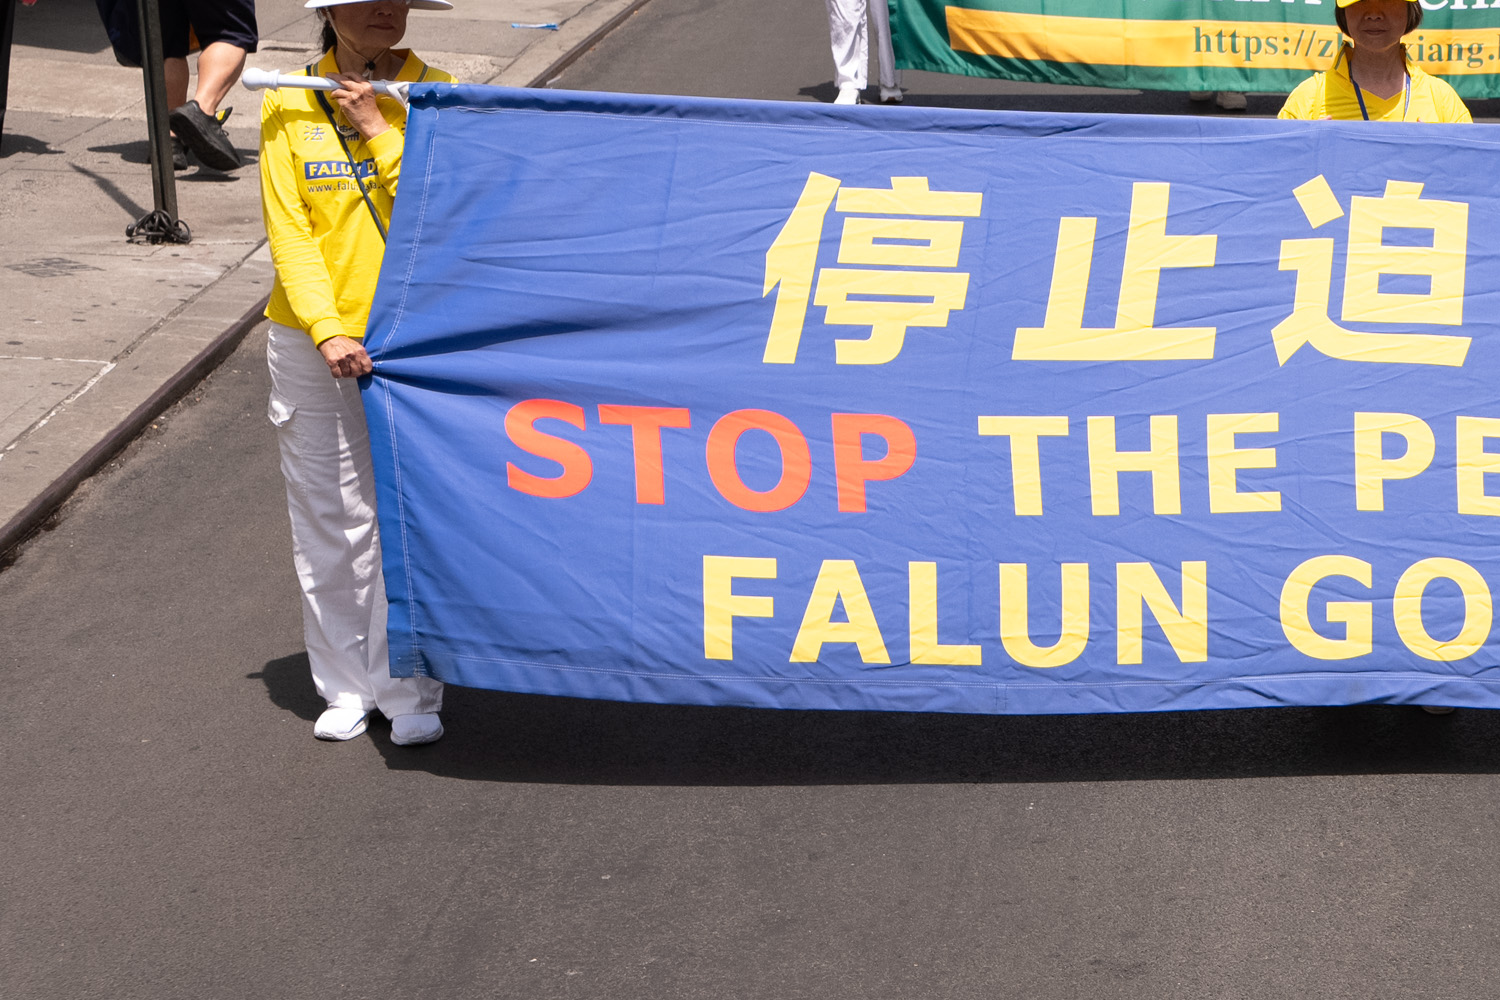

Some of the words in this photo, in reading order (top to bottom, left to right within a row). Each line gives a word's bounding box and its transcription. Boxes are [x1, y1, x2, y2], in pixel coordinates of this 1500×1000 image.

[503, 397, 918, 513] STOP
[978, 411, 1283, 517] THE
[702, 553, 1210, 668] FALUN
